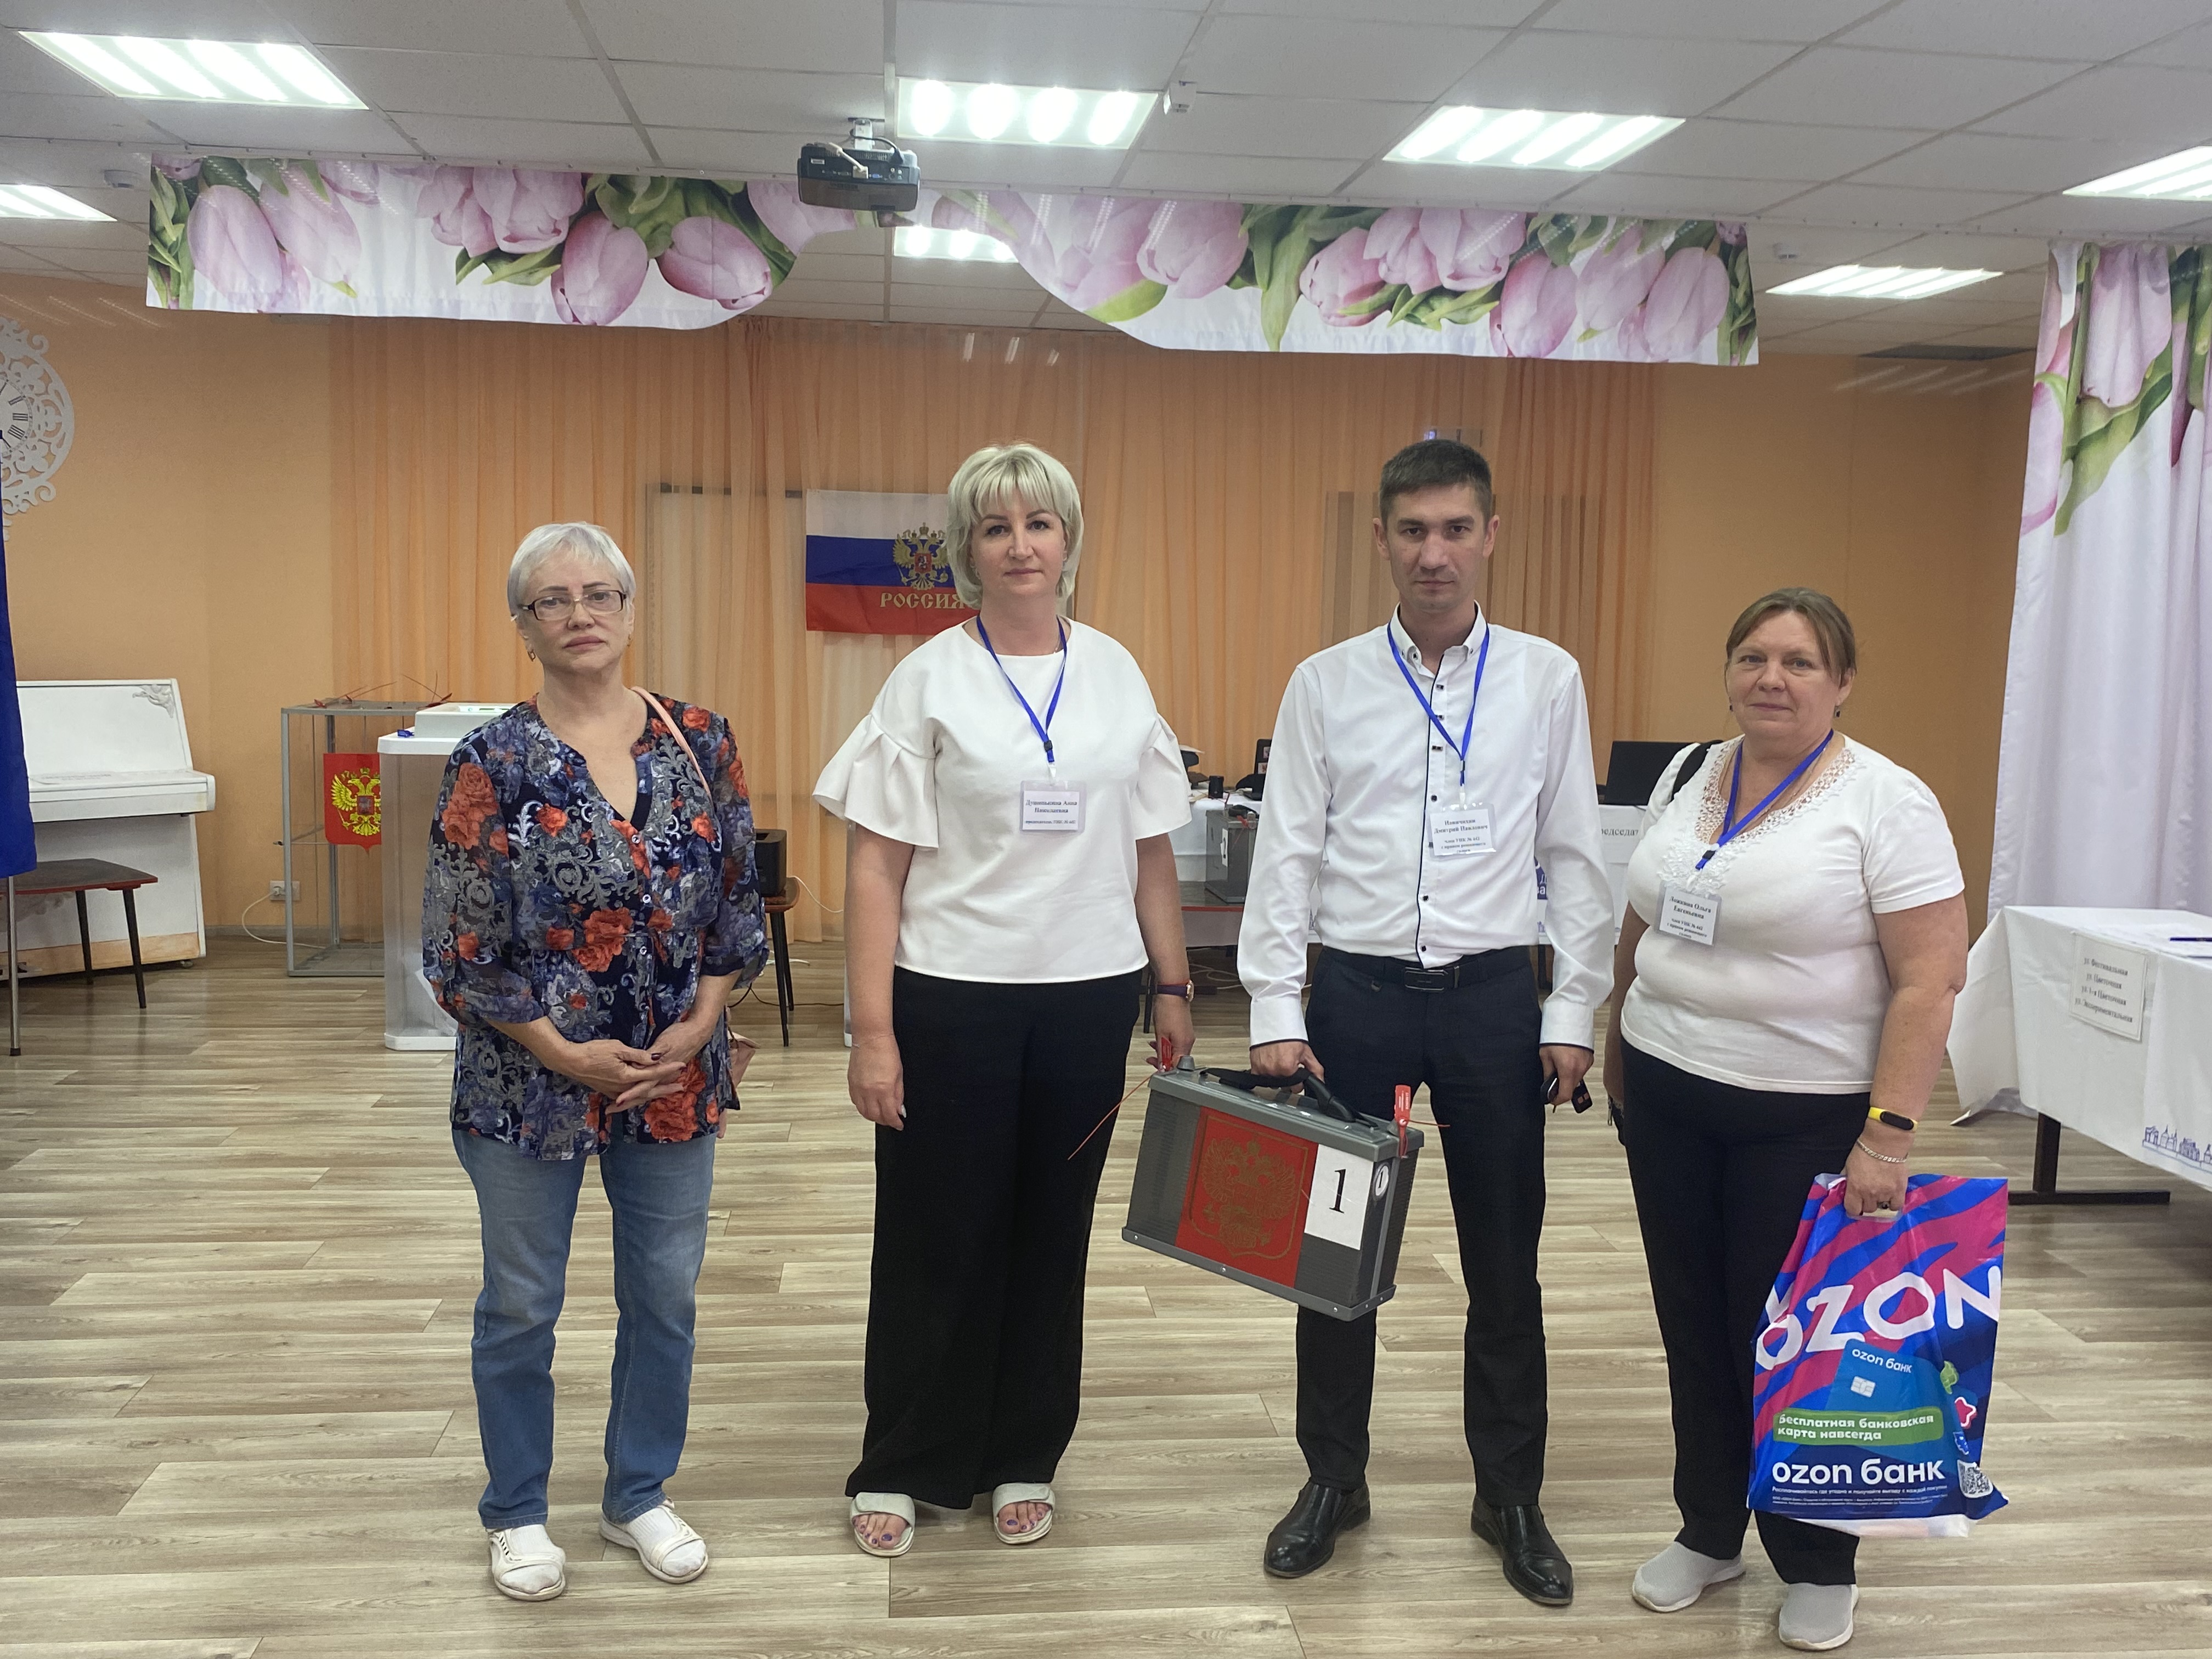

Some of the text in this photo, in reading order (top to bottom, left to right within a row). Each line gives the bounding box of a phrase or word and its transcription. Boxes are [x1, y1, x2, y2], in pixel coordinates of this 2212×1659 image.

[880, 592, 965, 610] РОССИЯ
[1673, 905, 1704, 919] Евгеньевна
[1694, 904, 1711, 913] Ольга
[1378, 1170, 1384, 1188] 1
[1329, 1169, 1346, 1214] 1
[1756, 1266, 2001, 1370] OZON
[1852, 1348, 1912, 1374] ozon банк
[1859, 1415, 1934, 1429] банковская
[1778, 1427, 1882, 1441] карта навсегда
[1772, 1458, 1946, 1485] ozon банк
